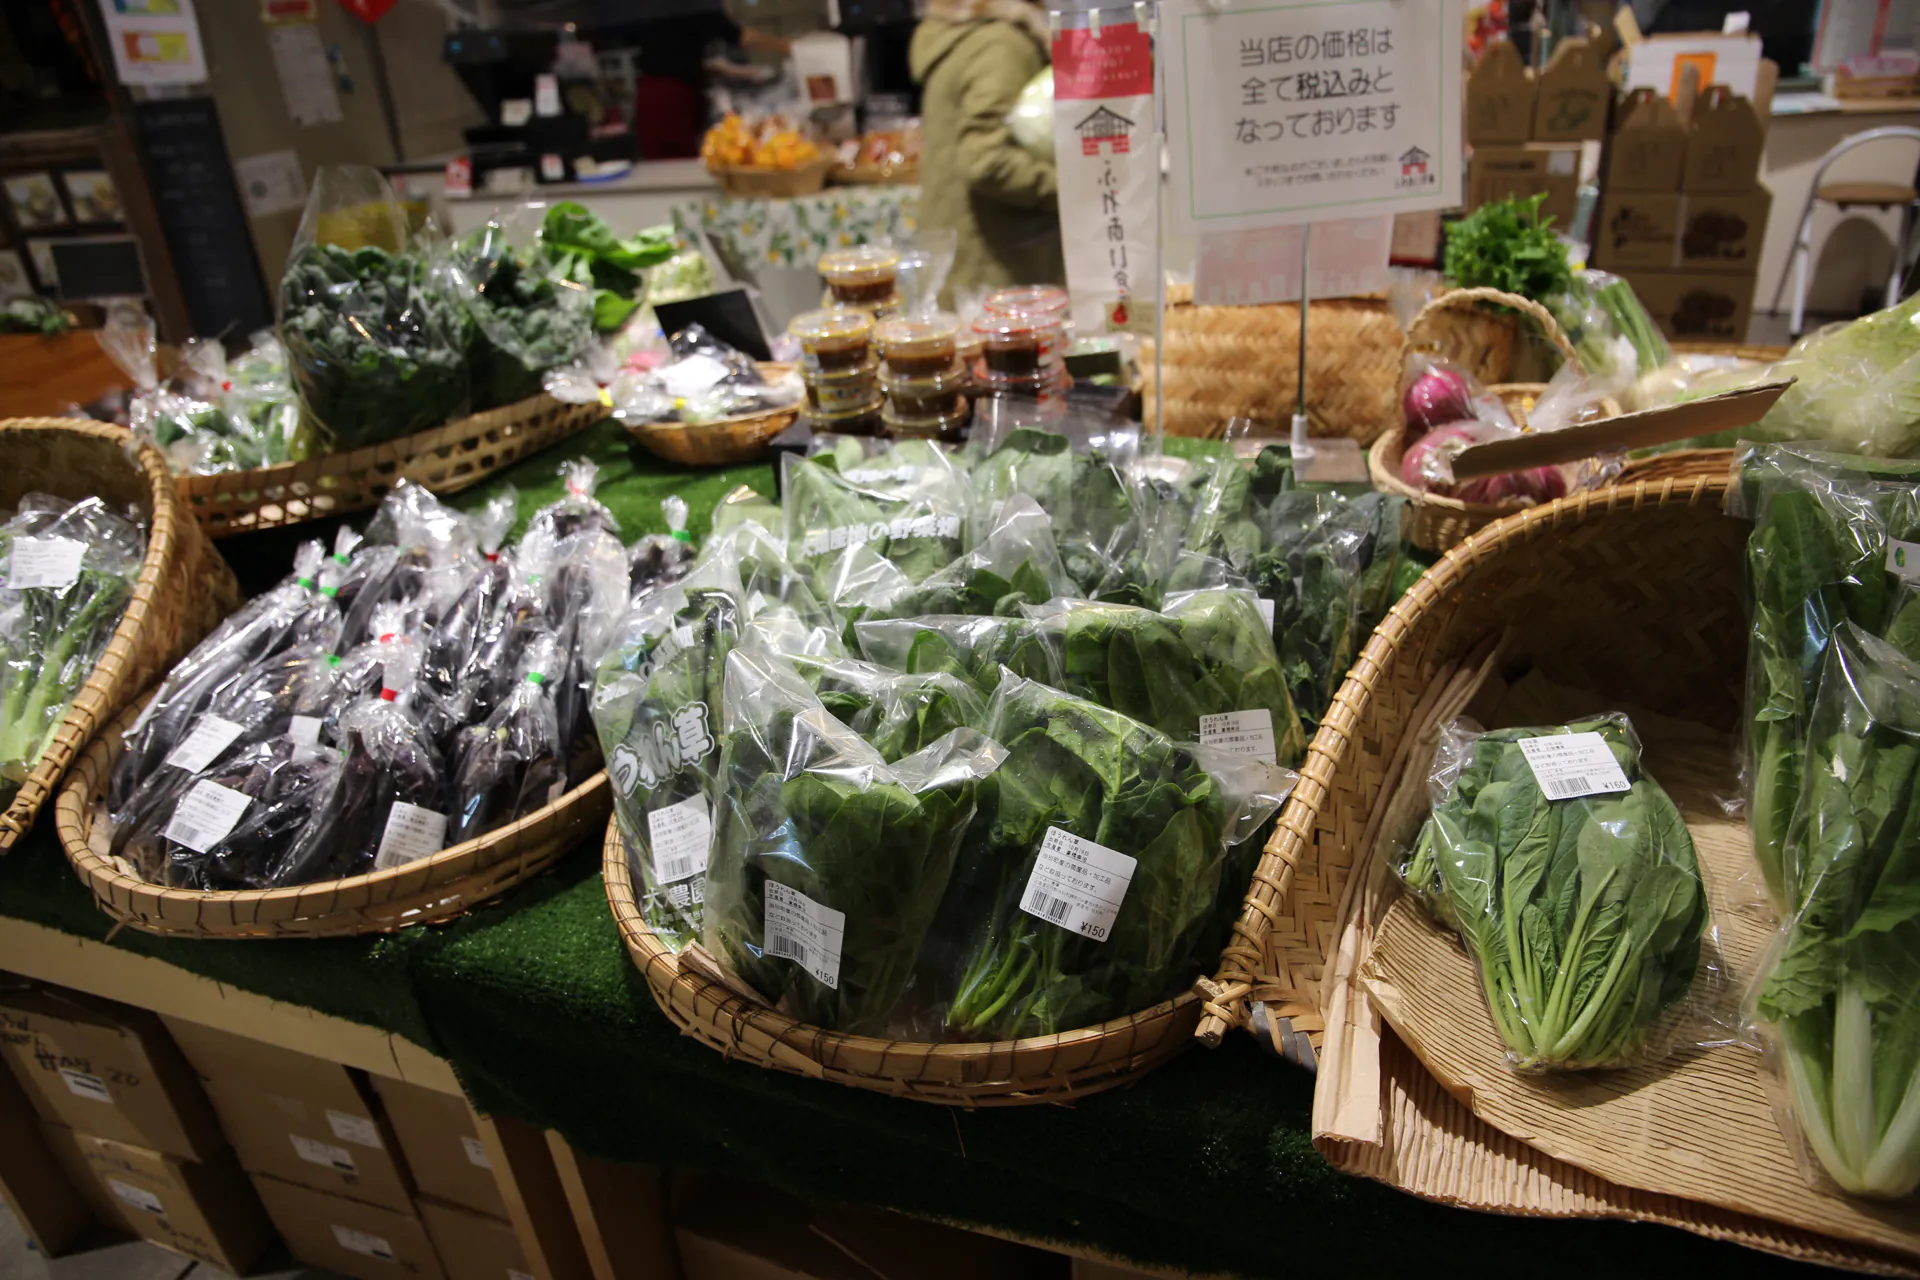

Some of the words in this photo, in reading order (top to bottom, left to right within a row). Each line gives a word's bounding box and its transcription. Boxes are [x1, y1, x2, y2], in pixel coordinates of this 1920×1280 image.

[1240, 27, 1394, 67] 当店の価格は
[1241, 66, 1394, 105] 全て税込みと
[1236, 102, 1400, 144] なっております
[1602, 781, 1626, 789] ¥160
[1050, 829, 1079, 845] ほうれん草
[769, 882, 796, 896] ほうれん草
[1079, 919, 1106, 939] ¥150
[815, 965, 834, 985] ¥150
